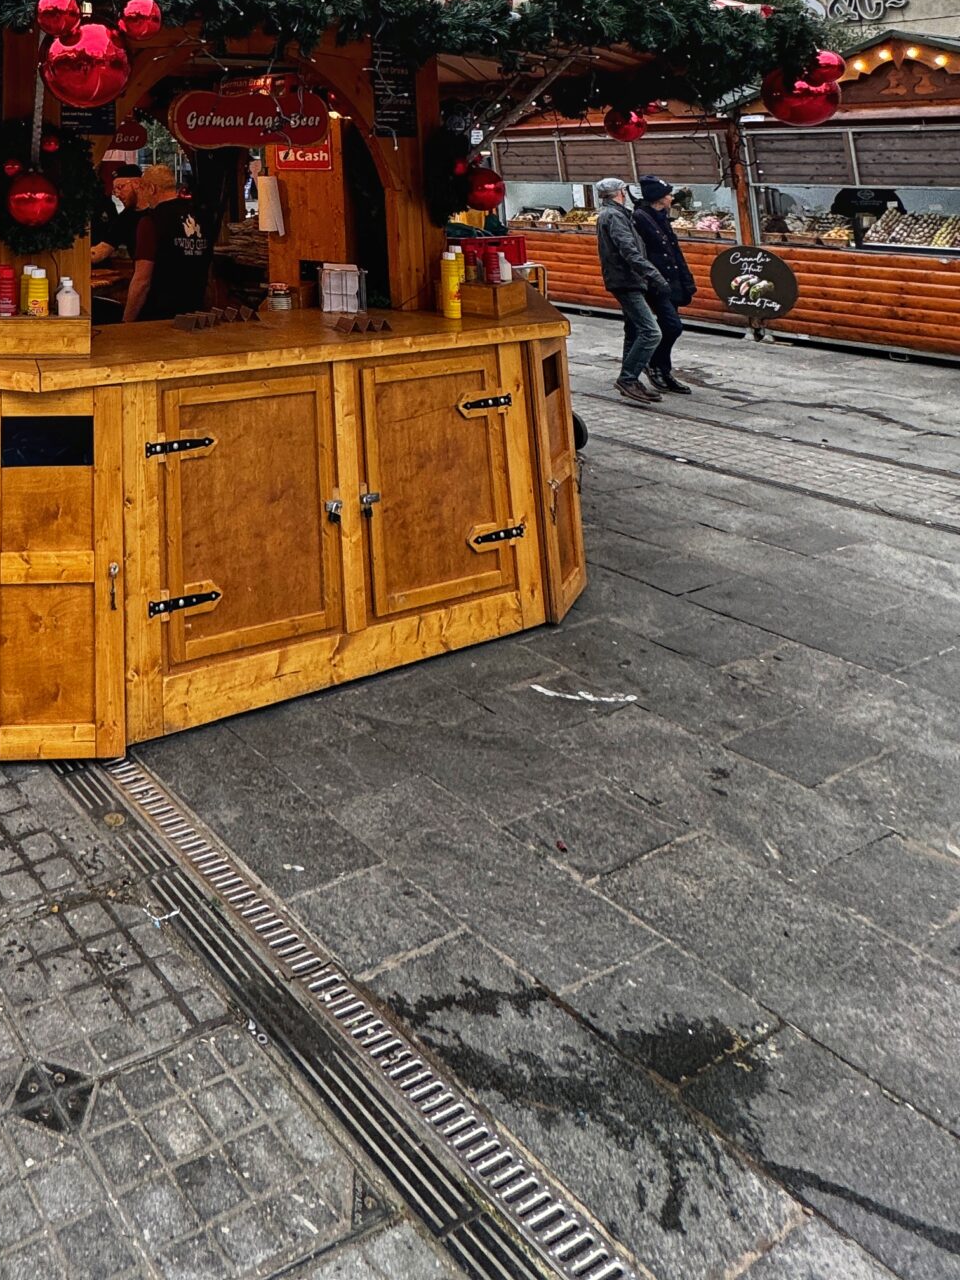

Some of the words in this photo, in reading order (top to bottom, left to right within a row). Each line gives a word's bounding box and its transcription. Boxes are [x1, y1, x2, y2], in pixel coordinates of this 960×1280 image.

[186, 111, 244, 130] German
[115, 132, 140, 144] Beer
[295, 149, 329, 162] Cash
